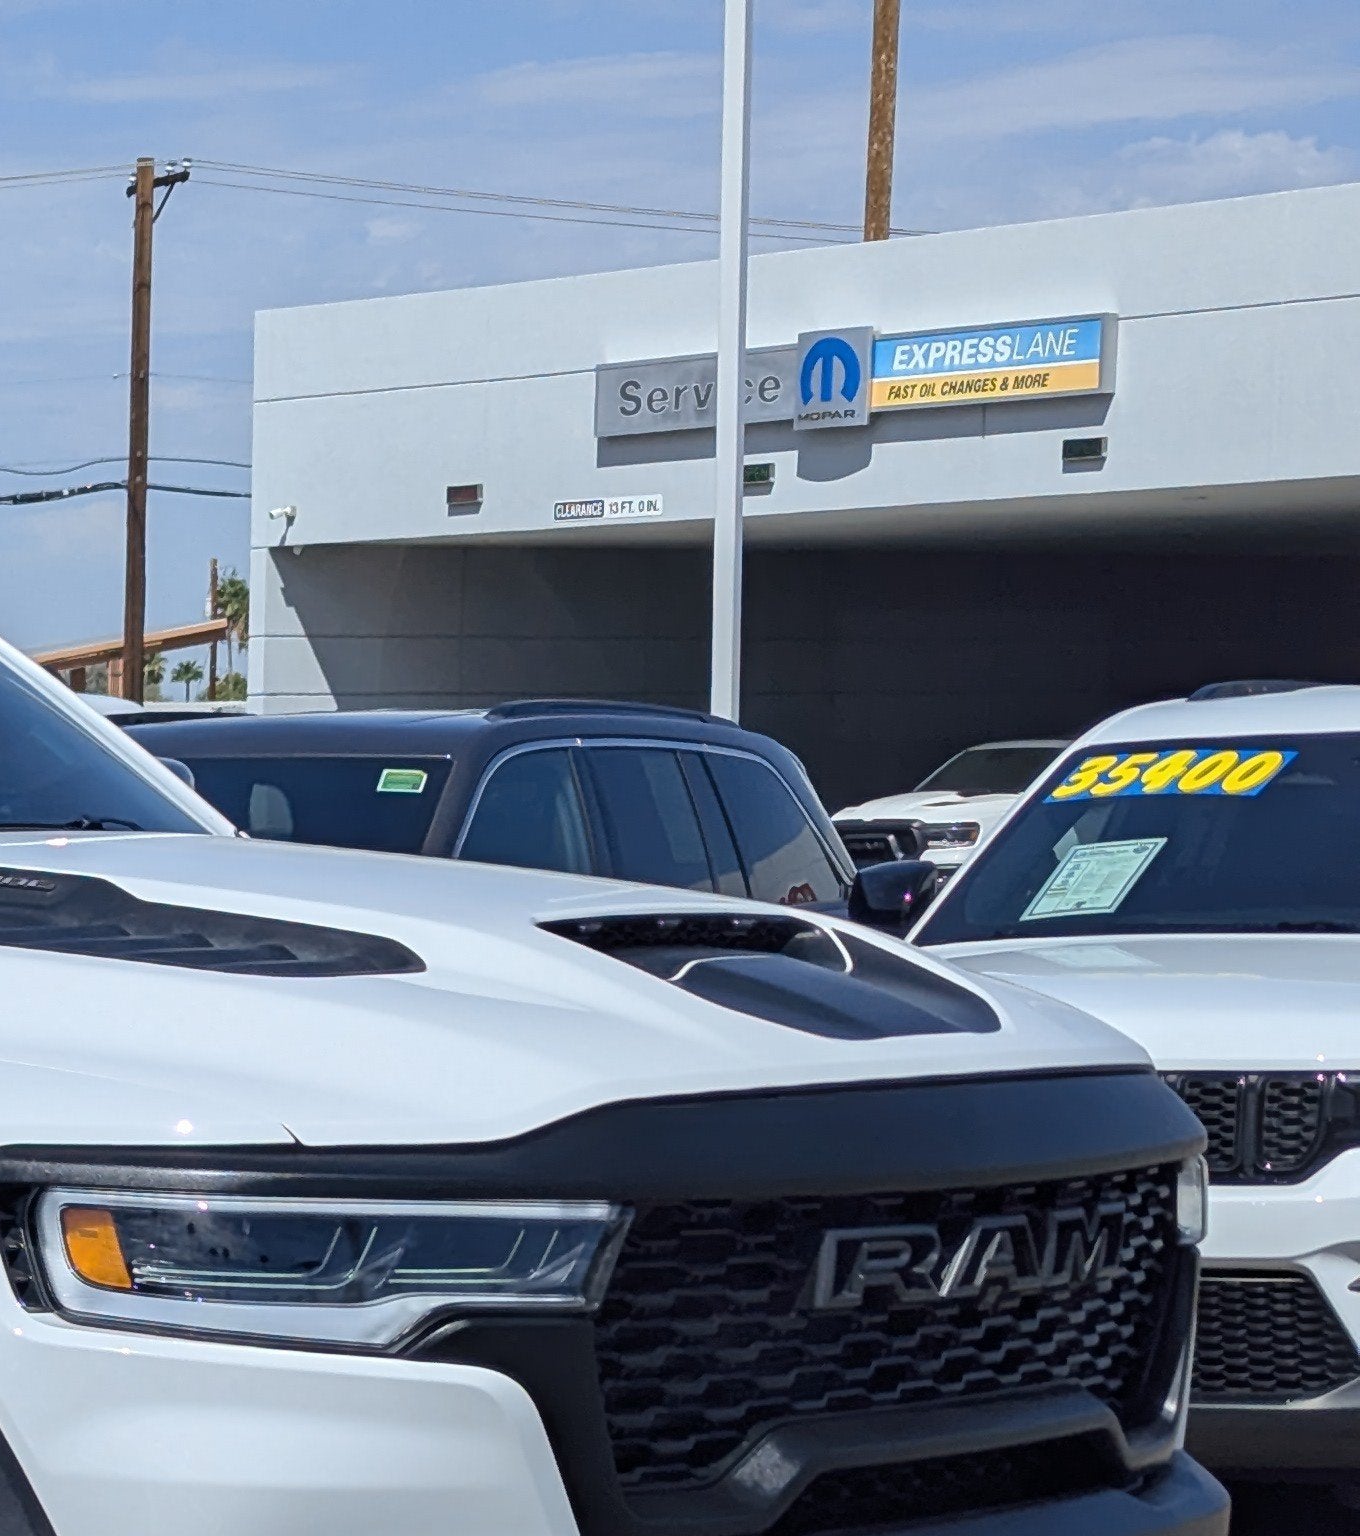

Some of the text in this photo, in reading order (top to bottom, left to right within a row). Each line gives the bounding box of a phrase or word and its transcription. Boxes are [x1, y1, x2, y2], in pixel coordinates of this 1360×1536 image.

[618, 375, 781, 417] Serve
[887, 372, 1051, 401] FAST OIL CHANGES & MORE
[797, 409, 856, 422] MOPAR
[608, 501, 619, 515] 13
[1051, 749, 1285, 799] 35400
[814, 1201, 1127, 1309] RAM
